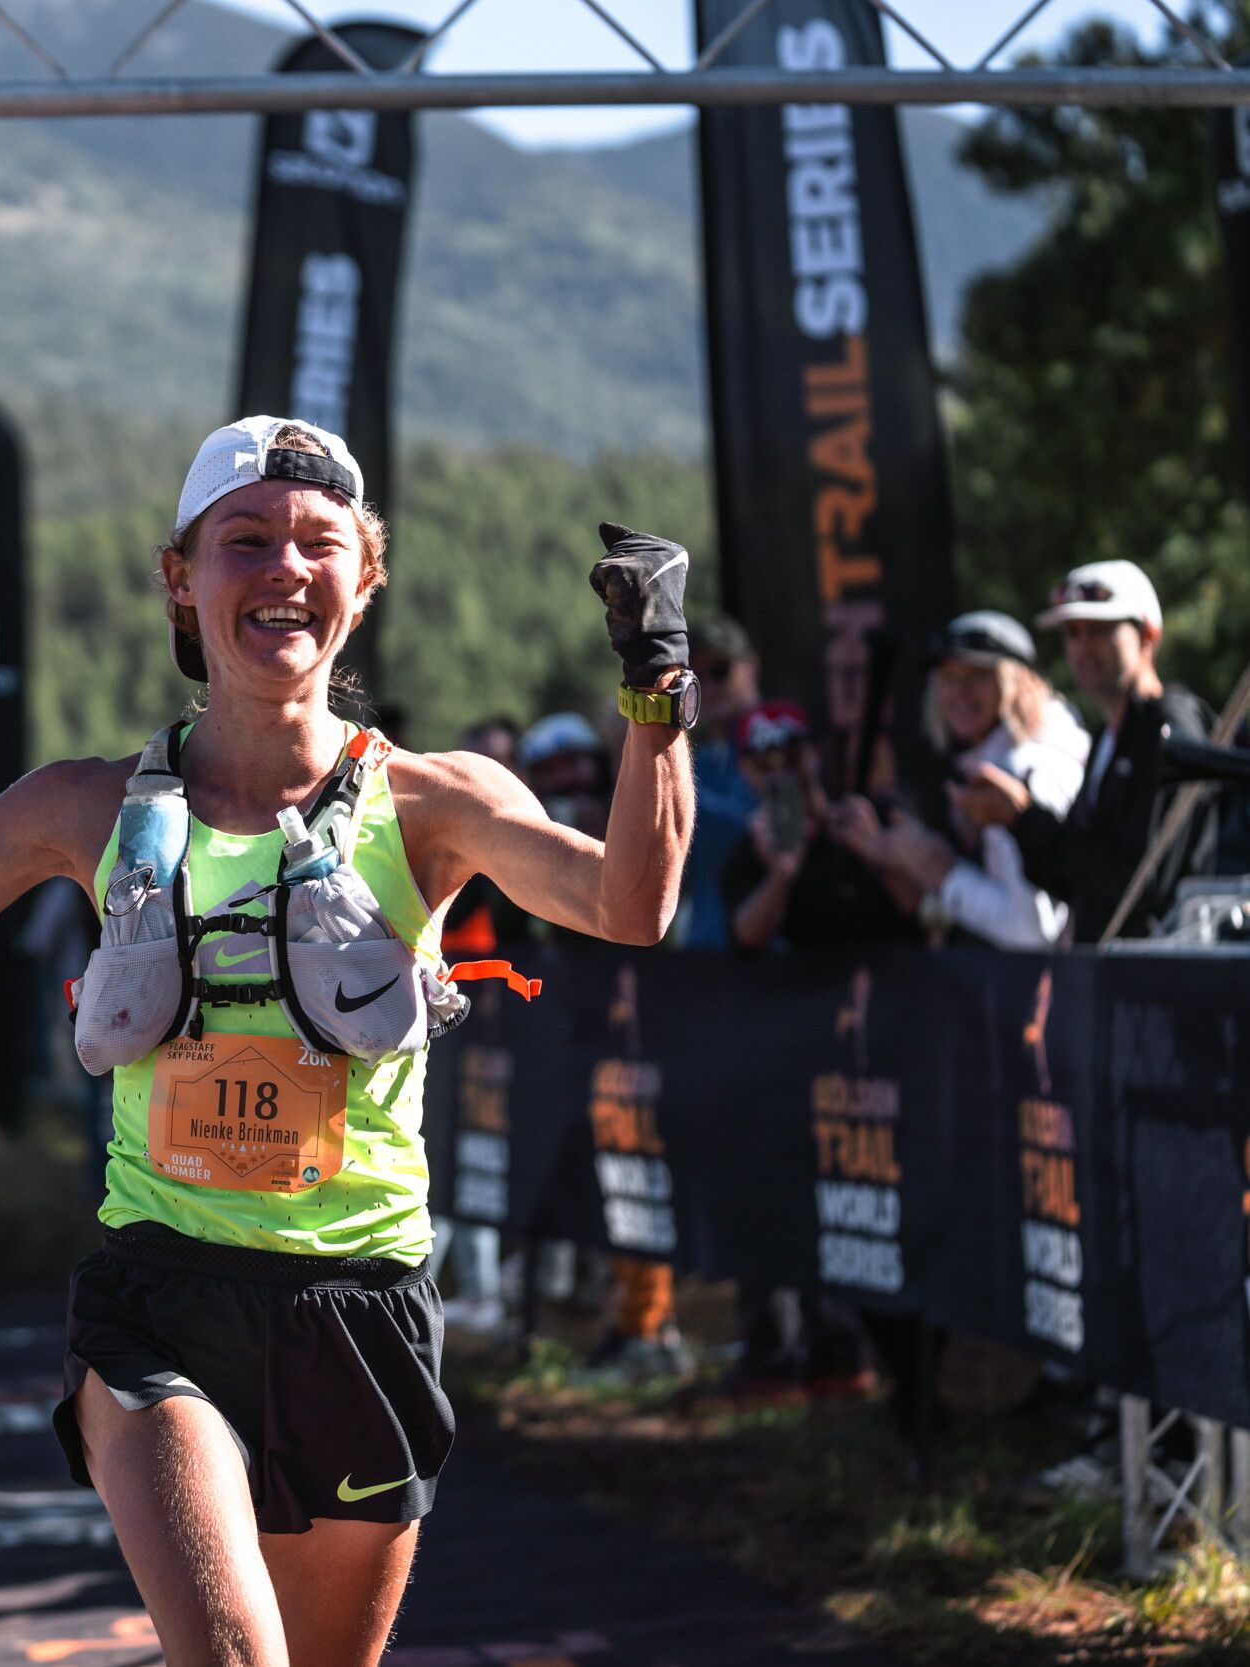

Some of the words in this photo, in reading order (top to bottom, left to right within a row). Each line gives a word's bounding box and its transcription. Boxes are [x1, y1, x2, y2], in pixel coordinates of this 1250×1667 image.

[169, 1042, 216, 1053] FLAGSTAFF
[166, 1050, 183, 1060] SKY
[185, 1051, 215, 1062] PEAKS
[214, 1078, 278, 1120] 118
[190, 1119, 233, 1141] Nienke
[238, 1121, 299, 1145] Brinkman
[171, 1153, 203, 1168] QUAD
[164, 1163, 211, 1181] BOMBER
